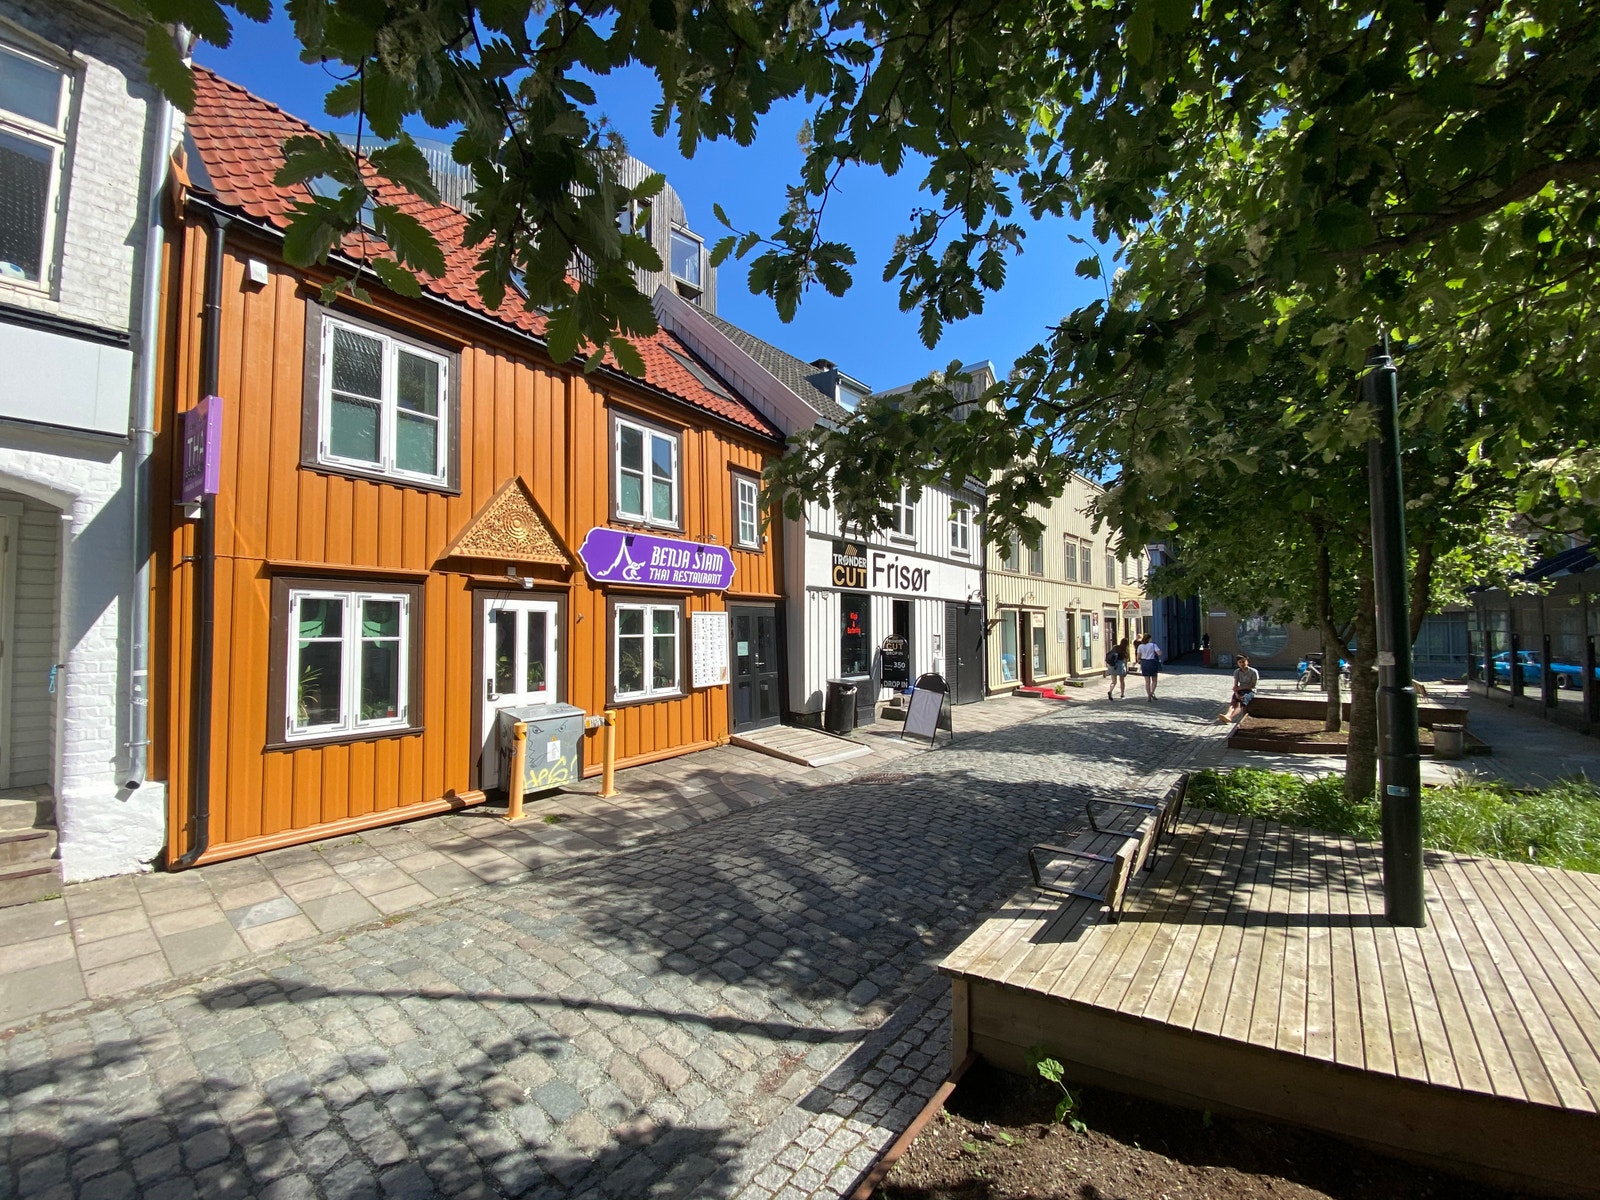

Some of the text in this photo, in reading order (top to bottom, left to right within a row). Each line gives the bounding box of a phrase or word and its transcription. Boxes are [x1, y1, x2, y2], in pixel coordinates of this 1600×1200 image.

[651, 546, 723, 572] BENJA SIAM
[832, 553, 867, 568] TRØNDER
[649, 568, 722, 585] THAI RESTAURANT
[833, 565, 867, 587] CUT
[873, 552, 931, 592] Frisør
[893, 661, 906, 669] 350
[883, 680, 900, 688] DROP
